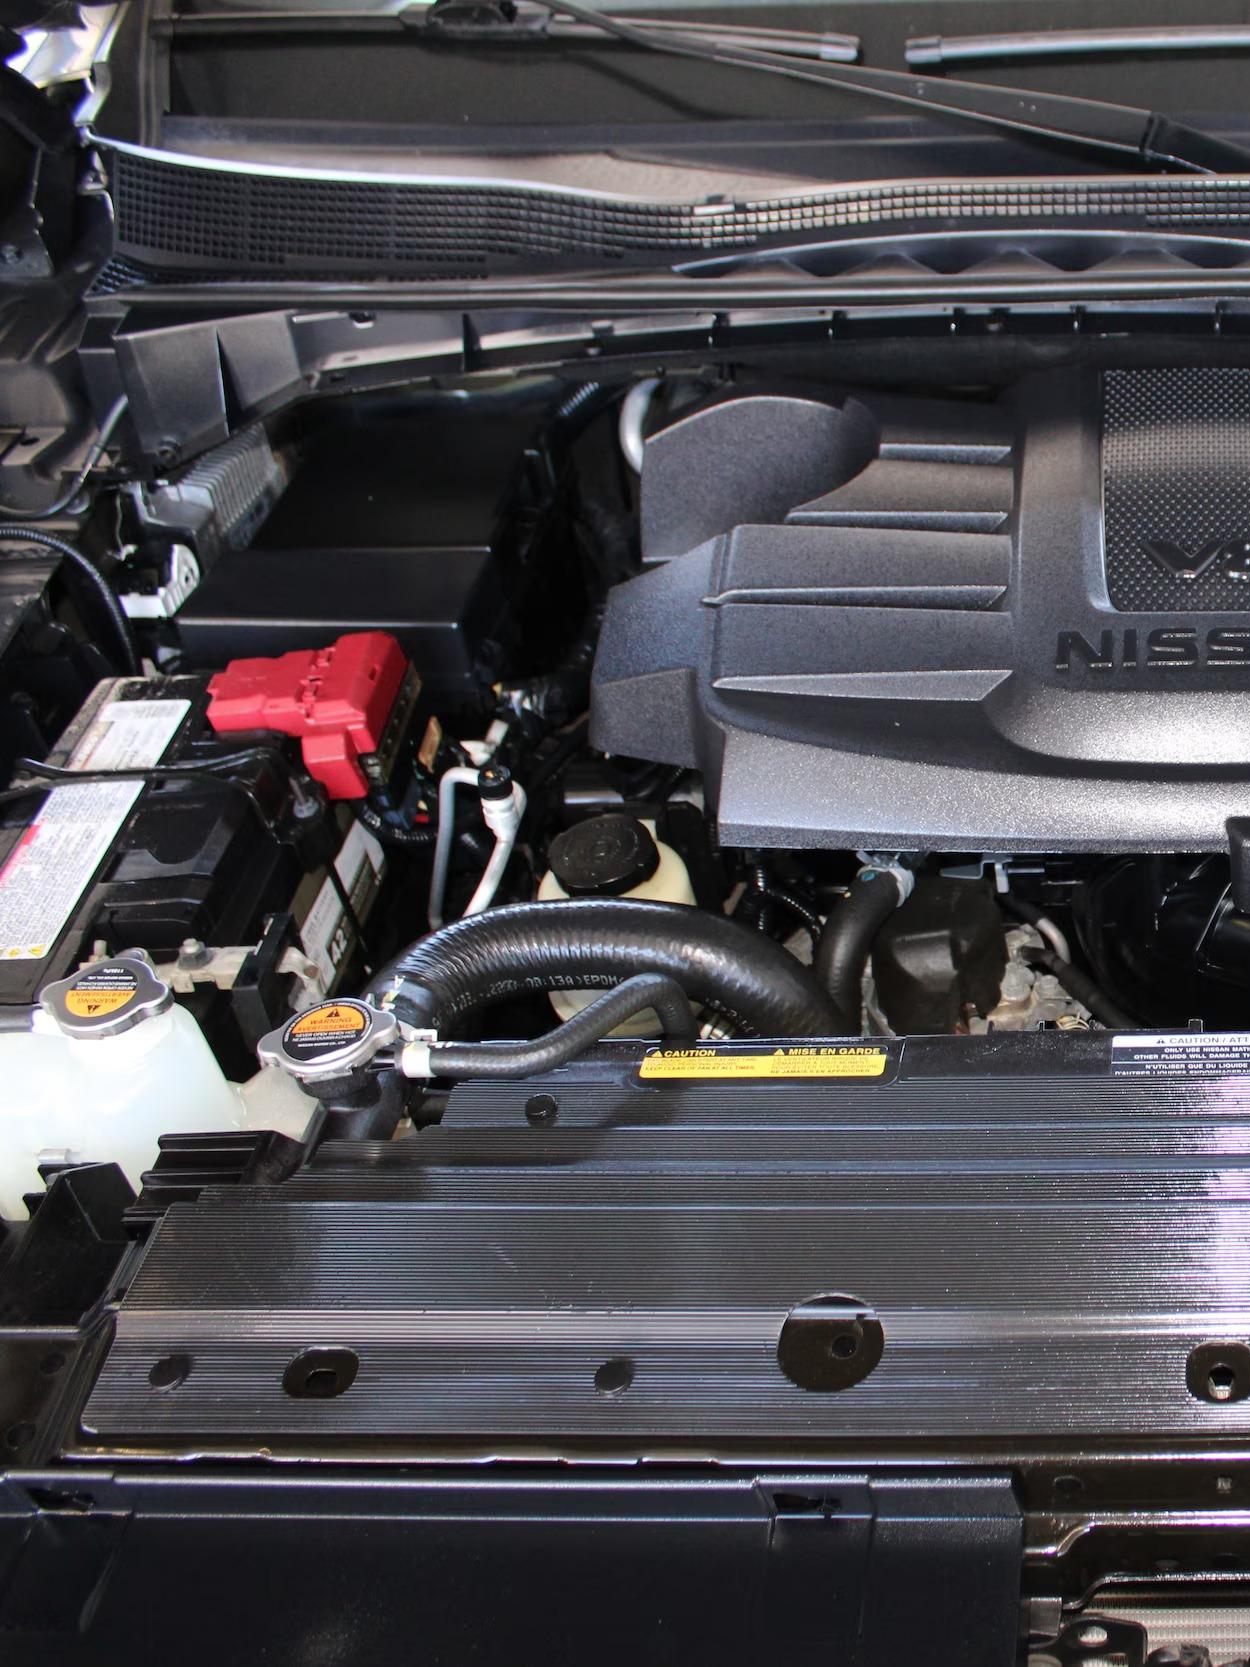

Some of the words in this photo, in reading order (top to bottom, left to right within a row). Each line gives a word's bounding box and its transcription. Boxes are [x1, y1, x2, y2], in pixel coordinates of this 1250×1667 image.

[331, 928, 347, 965] 42
[663, 1049, 716, 1057] CAUTION
[788, 1048, 818, 1056] MISE
[820, 1047, 837, 1055] EN
[839, 1047, 881, 1055] GARDE
